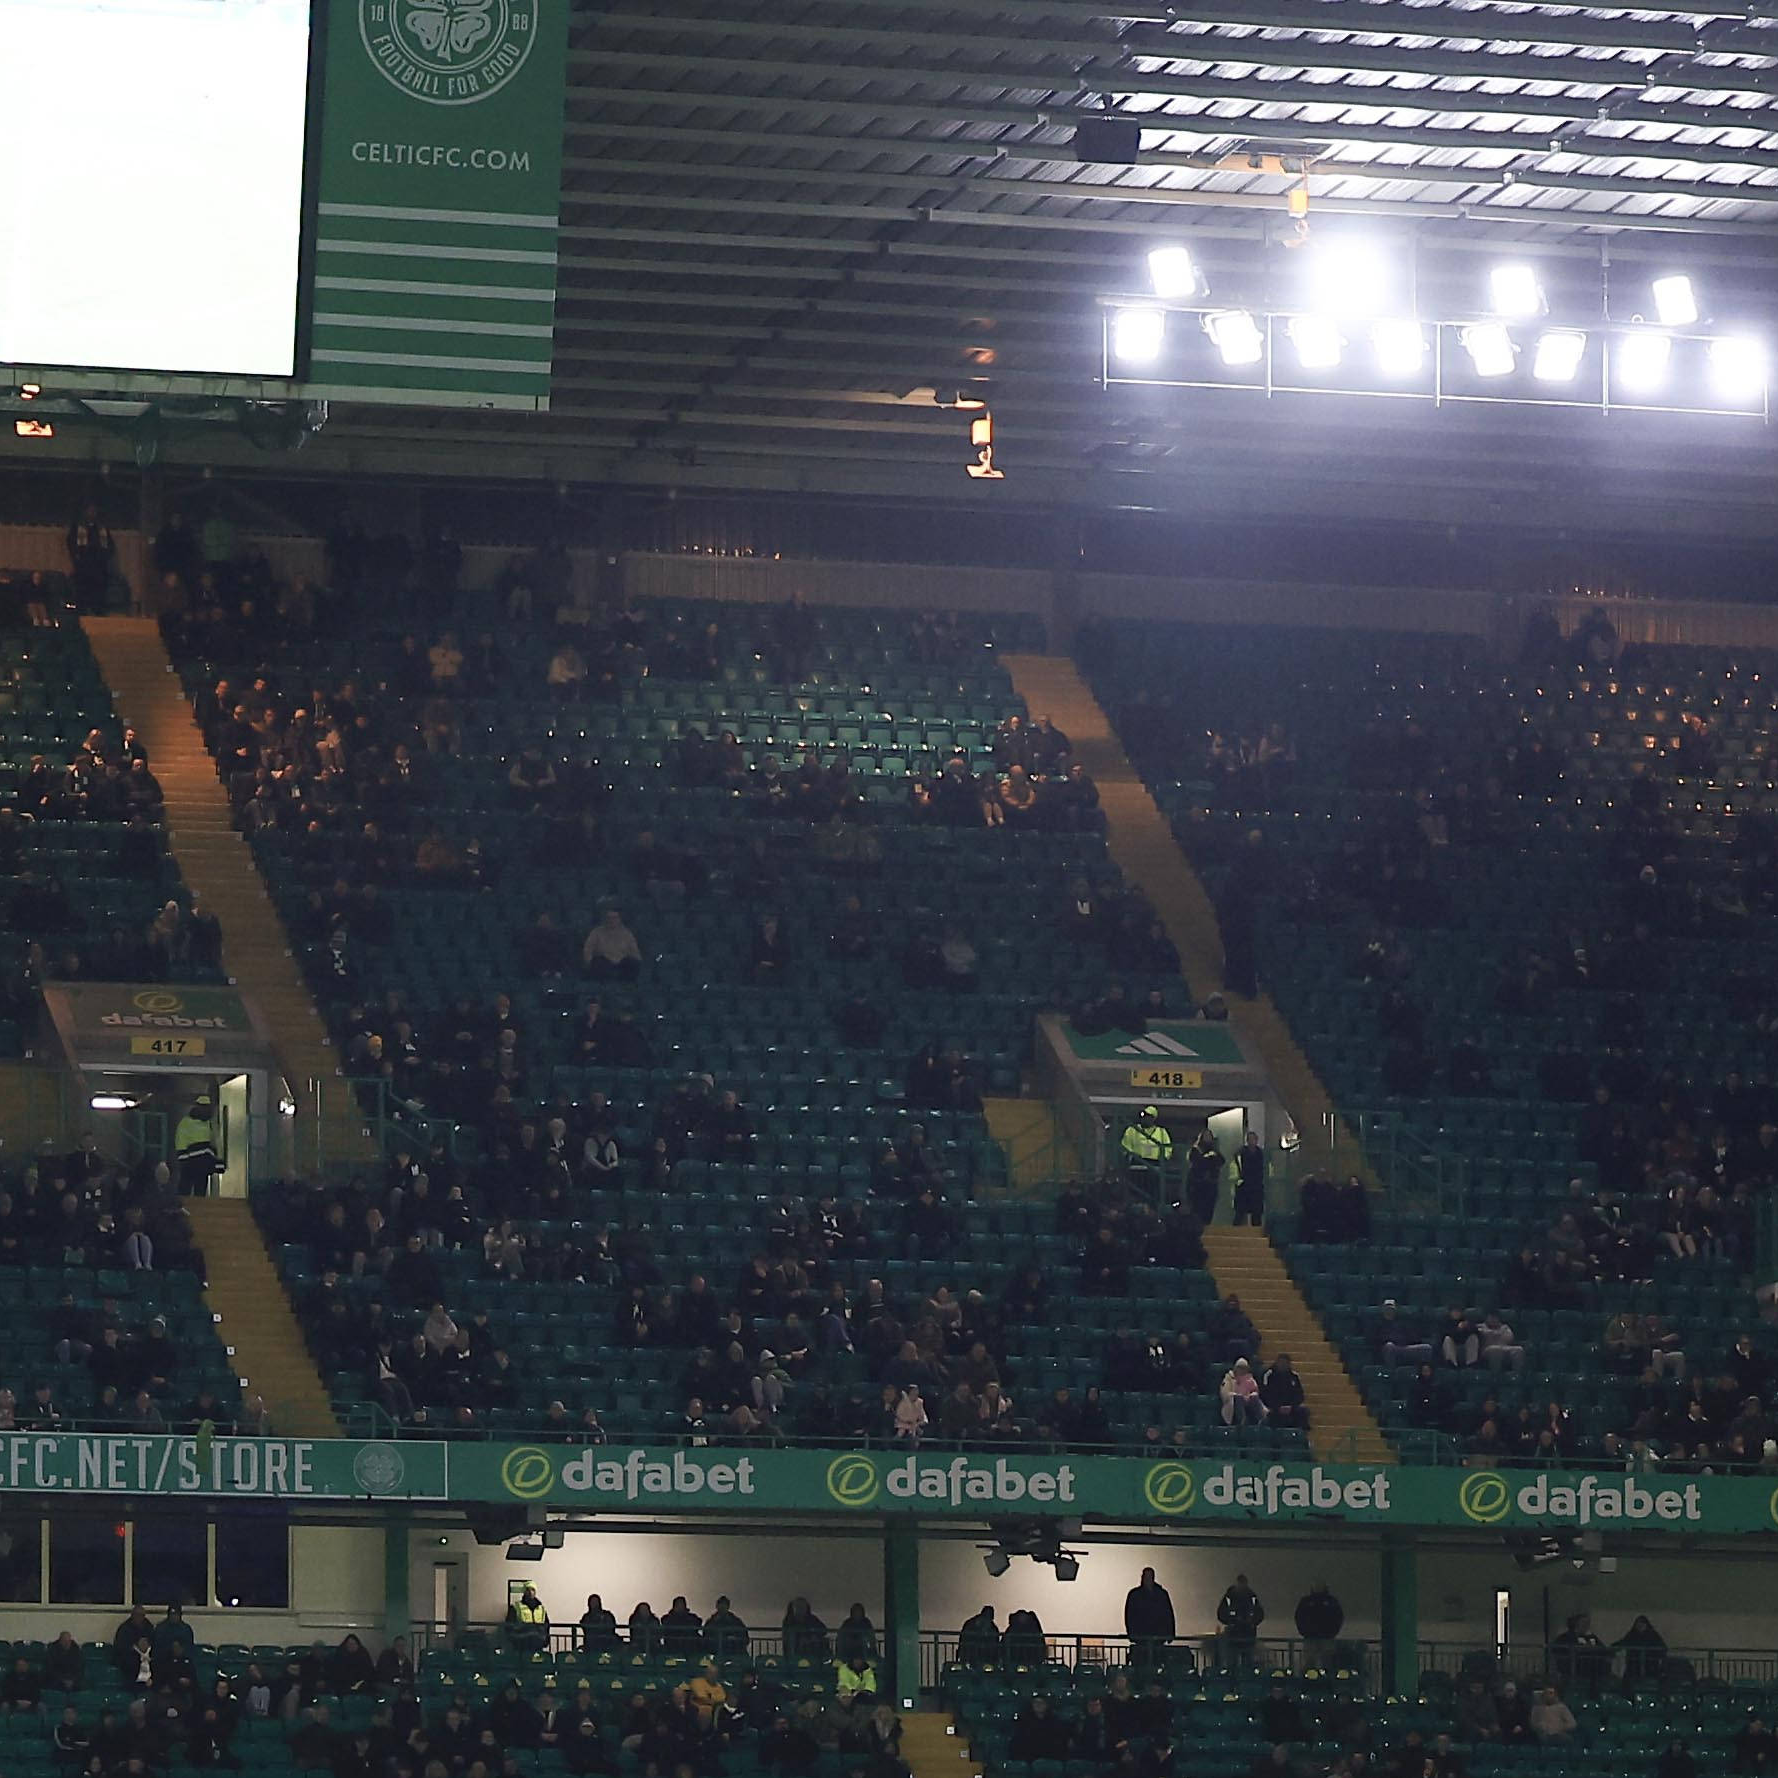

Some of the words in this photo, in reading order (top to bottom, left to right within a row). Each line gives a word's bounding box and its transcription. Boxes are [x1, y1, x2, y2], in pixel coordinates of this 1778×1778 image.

[373, 34, 439, 95] FOOTBALL
[448, 73, 480, 96] FOR
[482, 42, 521, 85] GOOD
[352, 142, 530, 171] CELTICFC.COM
[101, 1012, 226, 1029] dafabet
[151, 1039, 187, 1053] 417
[1149, 1072, 1183, 1086] 418
[562, 1448, 755, 1500] dafabet
[886, 1454, 1075, 1505] dafabet
[1203, 1464, 1391, 1515] dafabet
[1518, 1474, 1701, 1524] dafabet
